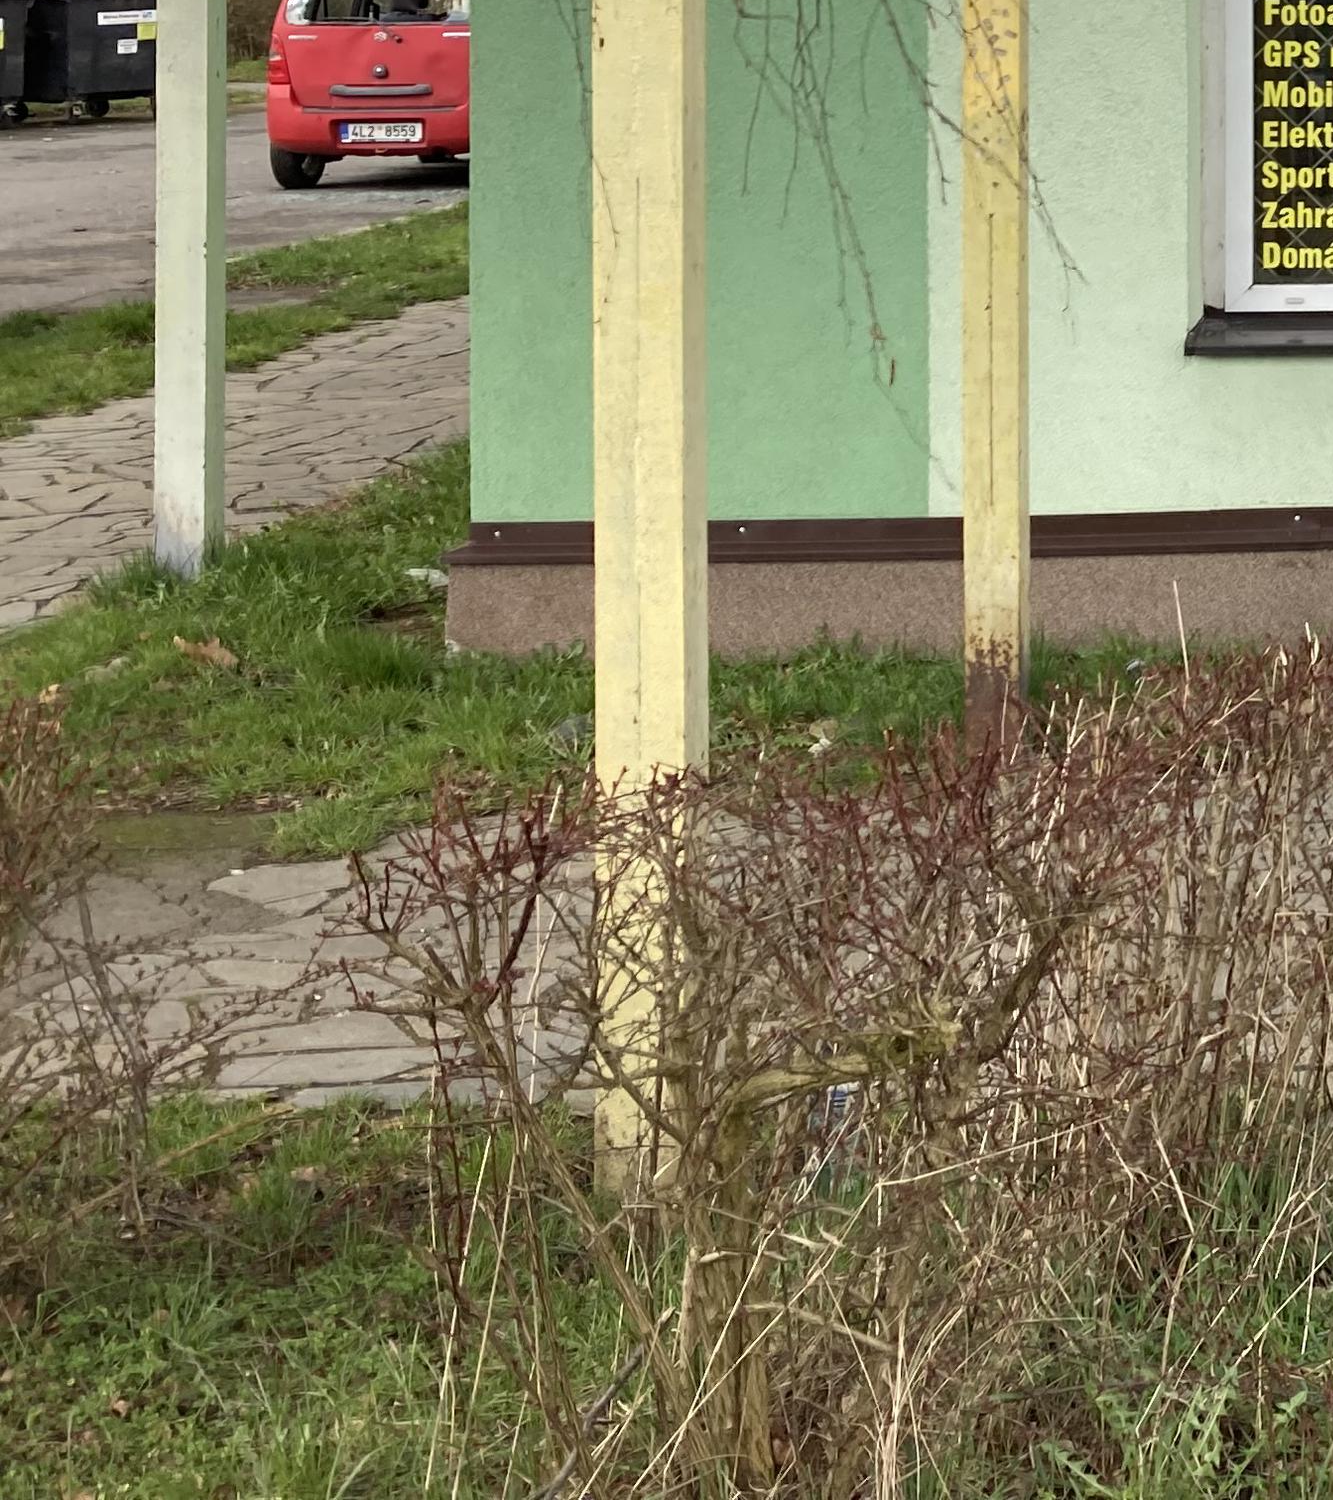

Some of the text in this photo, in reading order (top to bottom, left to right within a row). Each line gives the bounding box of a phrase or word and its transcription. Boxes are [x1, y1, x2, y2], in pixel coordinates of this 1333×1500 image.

[1263, 40, 1321, 68] GPS
[351, 125, 416, 138] 4L2 8559
